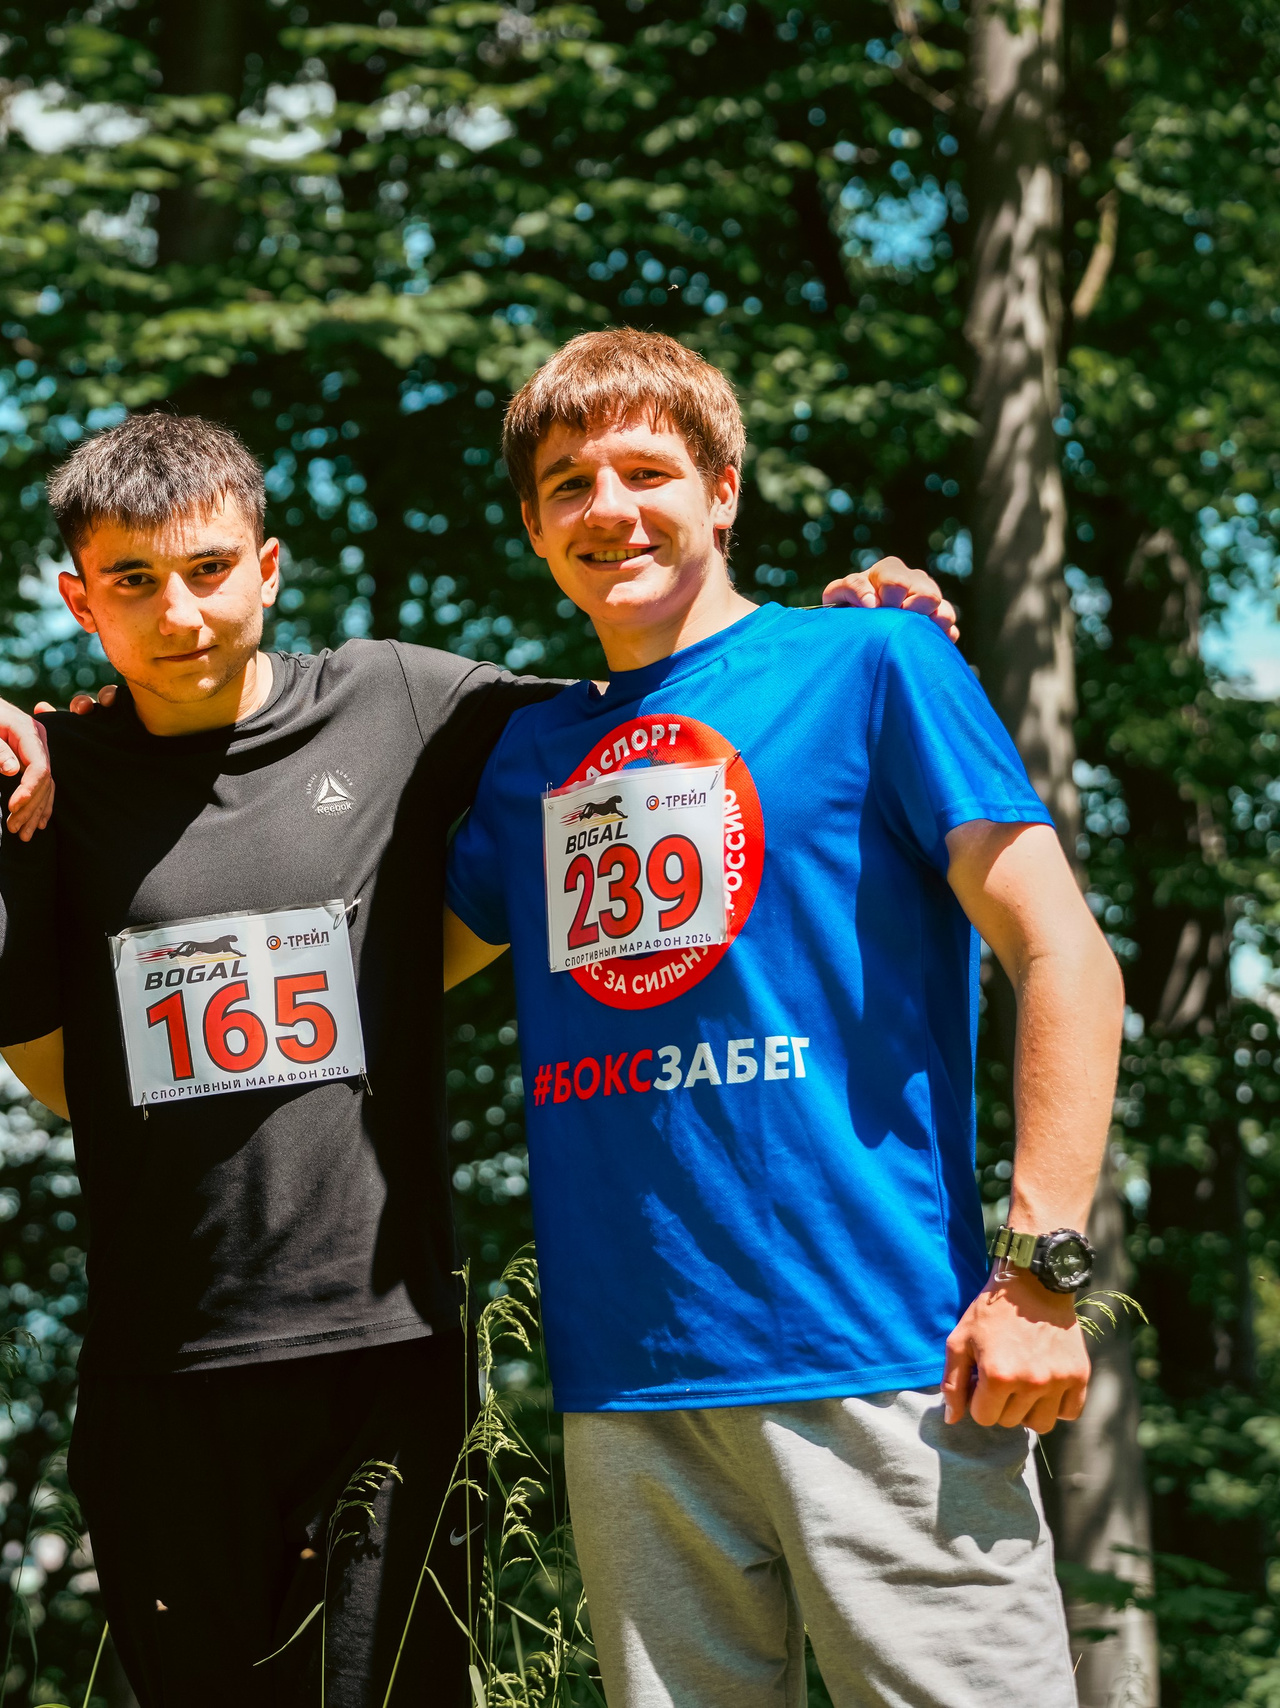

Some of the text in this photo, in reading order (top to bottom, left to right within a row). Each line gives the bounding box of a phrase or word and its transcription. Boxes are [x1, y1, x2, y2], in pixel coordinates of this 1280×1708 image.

[316, 802, 352, 814] Reebok
[565, 821, 629, 854] BOGAL
[564, 833, 704, 951] 239
[564, 933, 712, 968] СПОРТИВНЫЙ МАРАФОН 2026
[144, 959, 249, 991] BOGAL
[603, 970, 627, 994] ЗА
[145, 969, 338, 1082] 165
[150, 1065, 350, 1101] СПОРТИВНЫЙ МАРАФОН 2026
[533, 1035, 810, 1107] #БОКСЗАБЕГ
